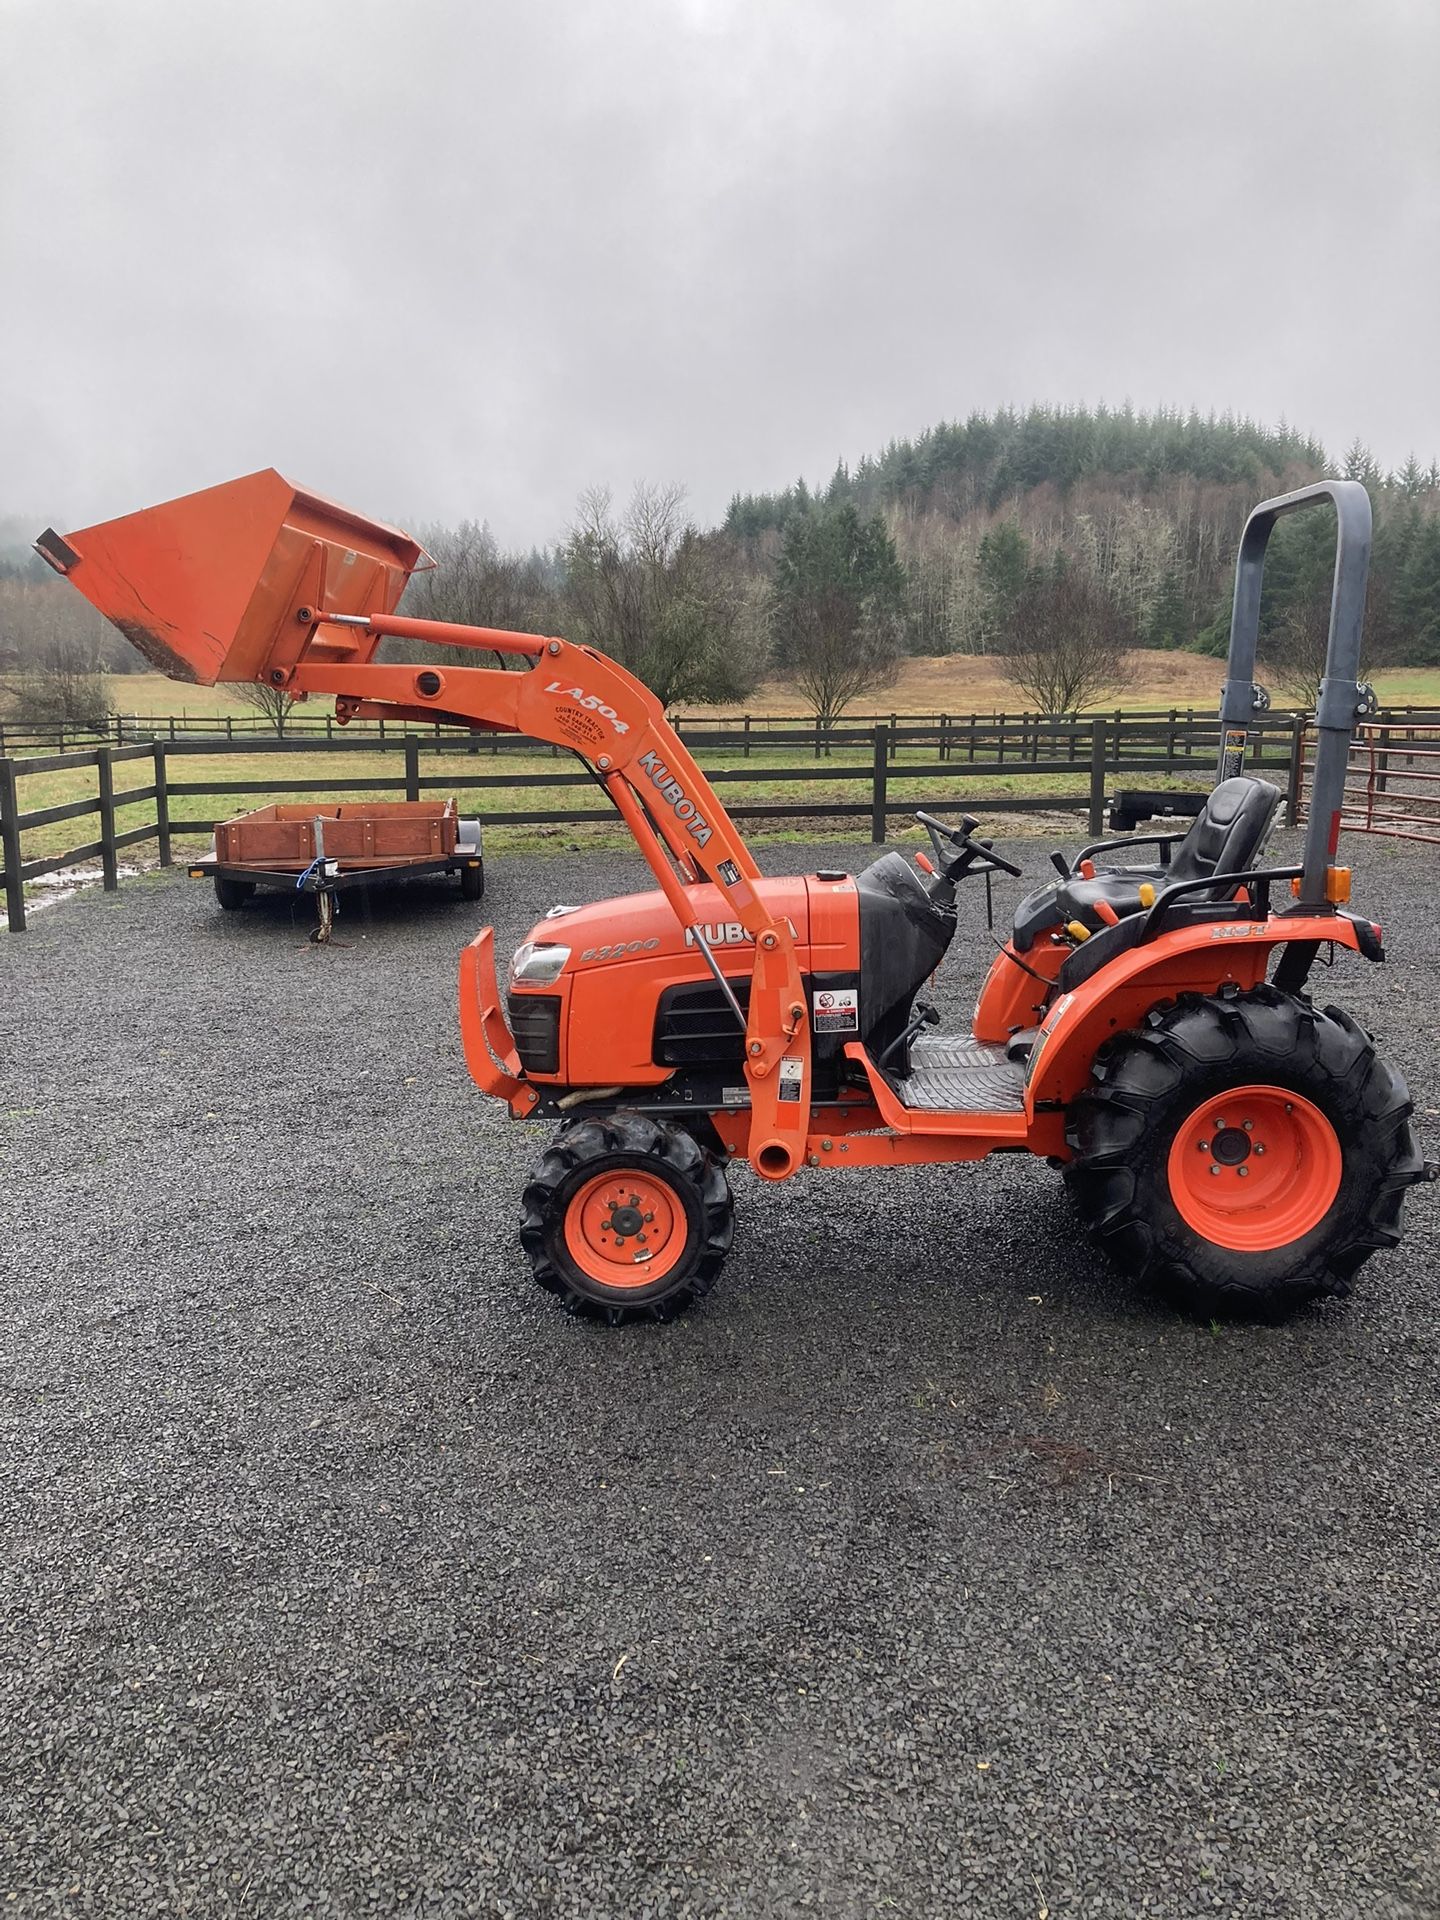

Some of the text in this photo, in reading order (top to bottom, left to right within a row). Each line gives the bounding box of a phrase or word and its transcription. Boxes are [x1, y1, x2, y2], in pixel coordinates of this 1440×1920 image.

[543, 681, 630, 735] LA504
[555, 706, 584, 718] COUNTRY
[584, 715, 605, 740] TRACTOR
[572, 717, 592, 732] GARDEN
[638, 749, 714, 849] KUBOTA
[684, 918, 799, 948] KUB
[580, 937, 660, 962] B3200
